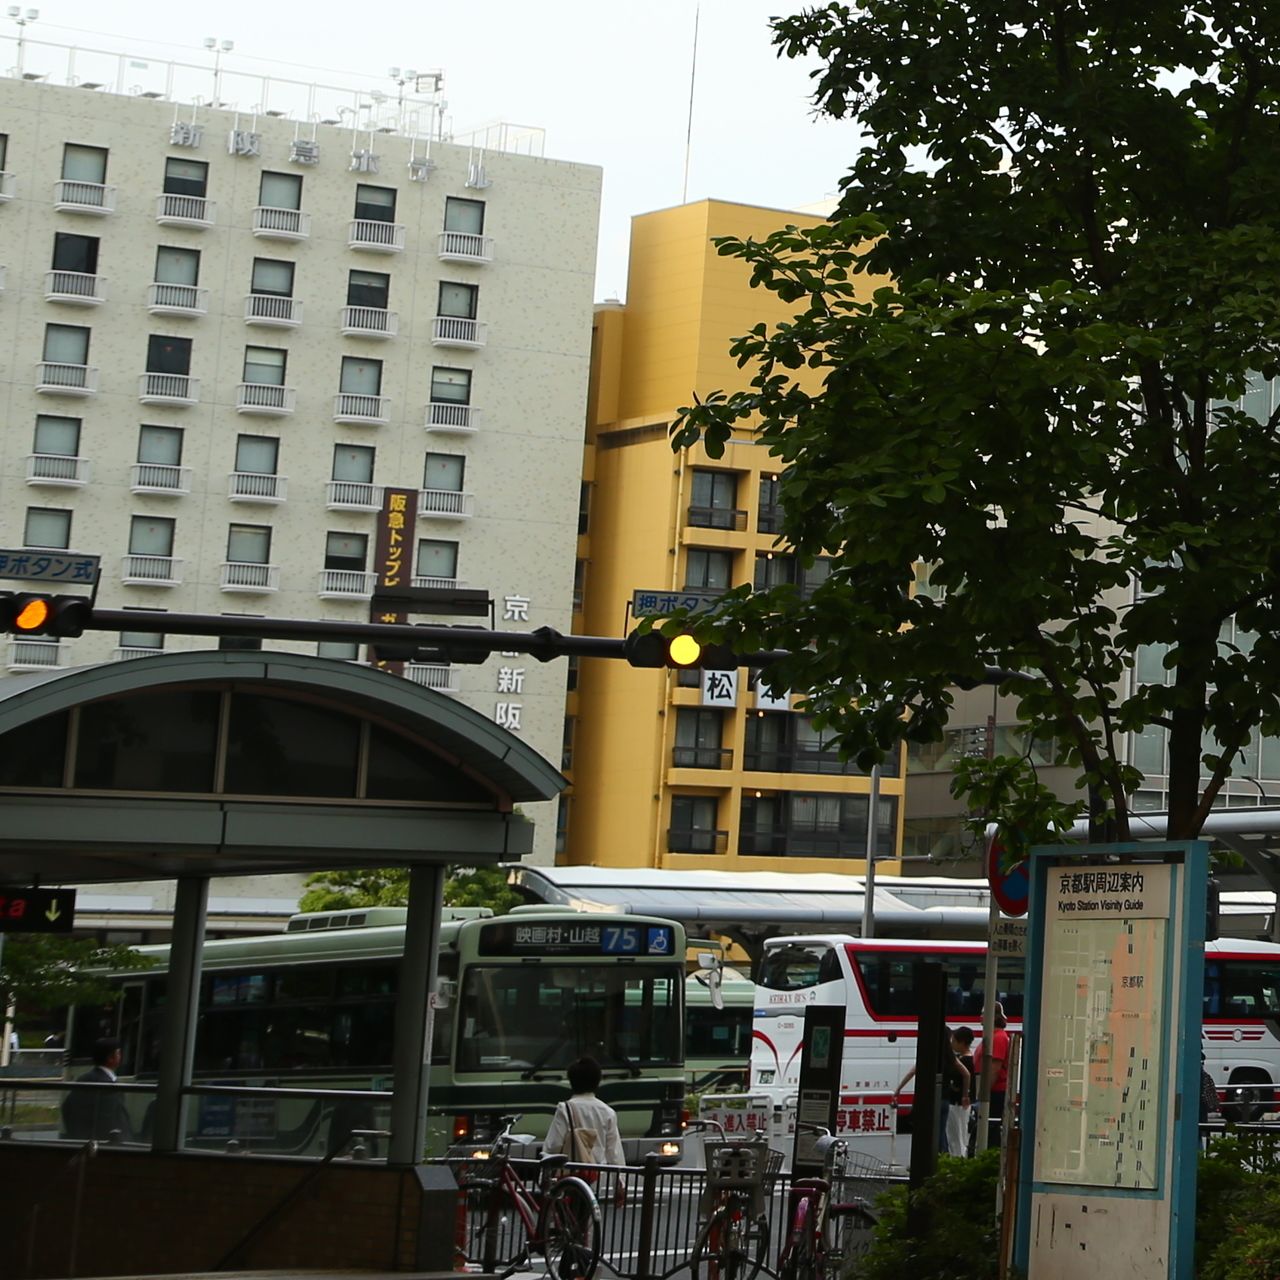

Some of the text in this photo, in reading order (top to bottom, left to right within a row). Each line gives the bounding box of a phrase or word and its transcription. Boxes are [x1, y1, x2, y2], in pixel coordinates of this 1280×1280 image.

[171, 121, 493, 190] 新阪急ホテル
[495, 595, 531, 730] 京新阪
[1060, 871, 1144, 894] 京都駅周辺案内
[1058, 901, 1076, 912] Kyoto
[1077, 901, 1099, 911] Station
[1124, 899, 1144, 910] Guide
[1264, 915, 1271, 931] 7
[607, 928, 636, 950] 75
